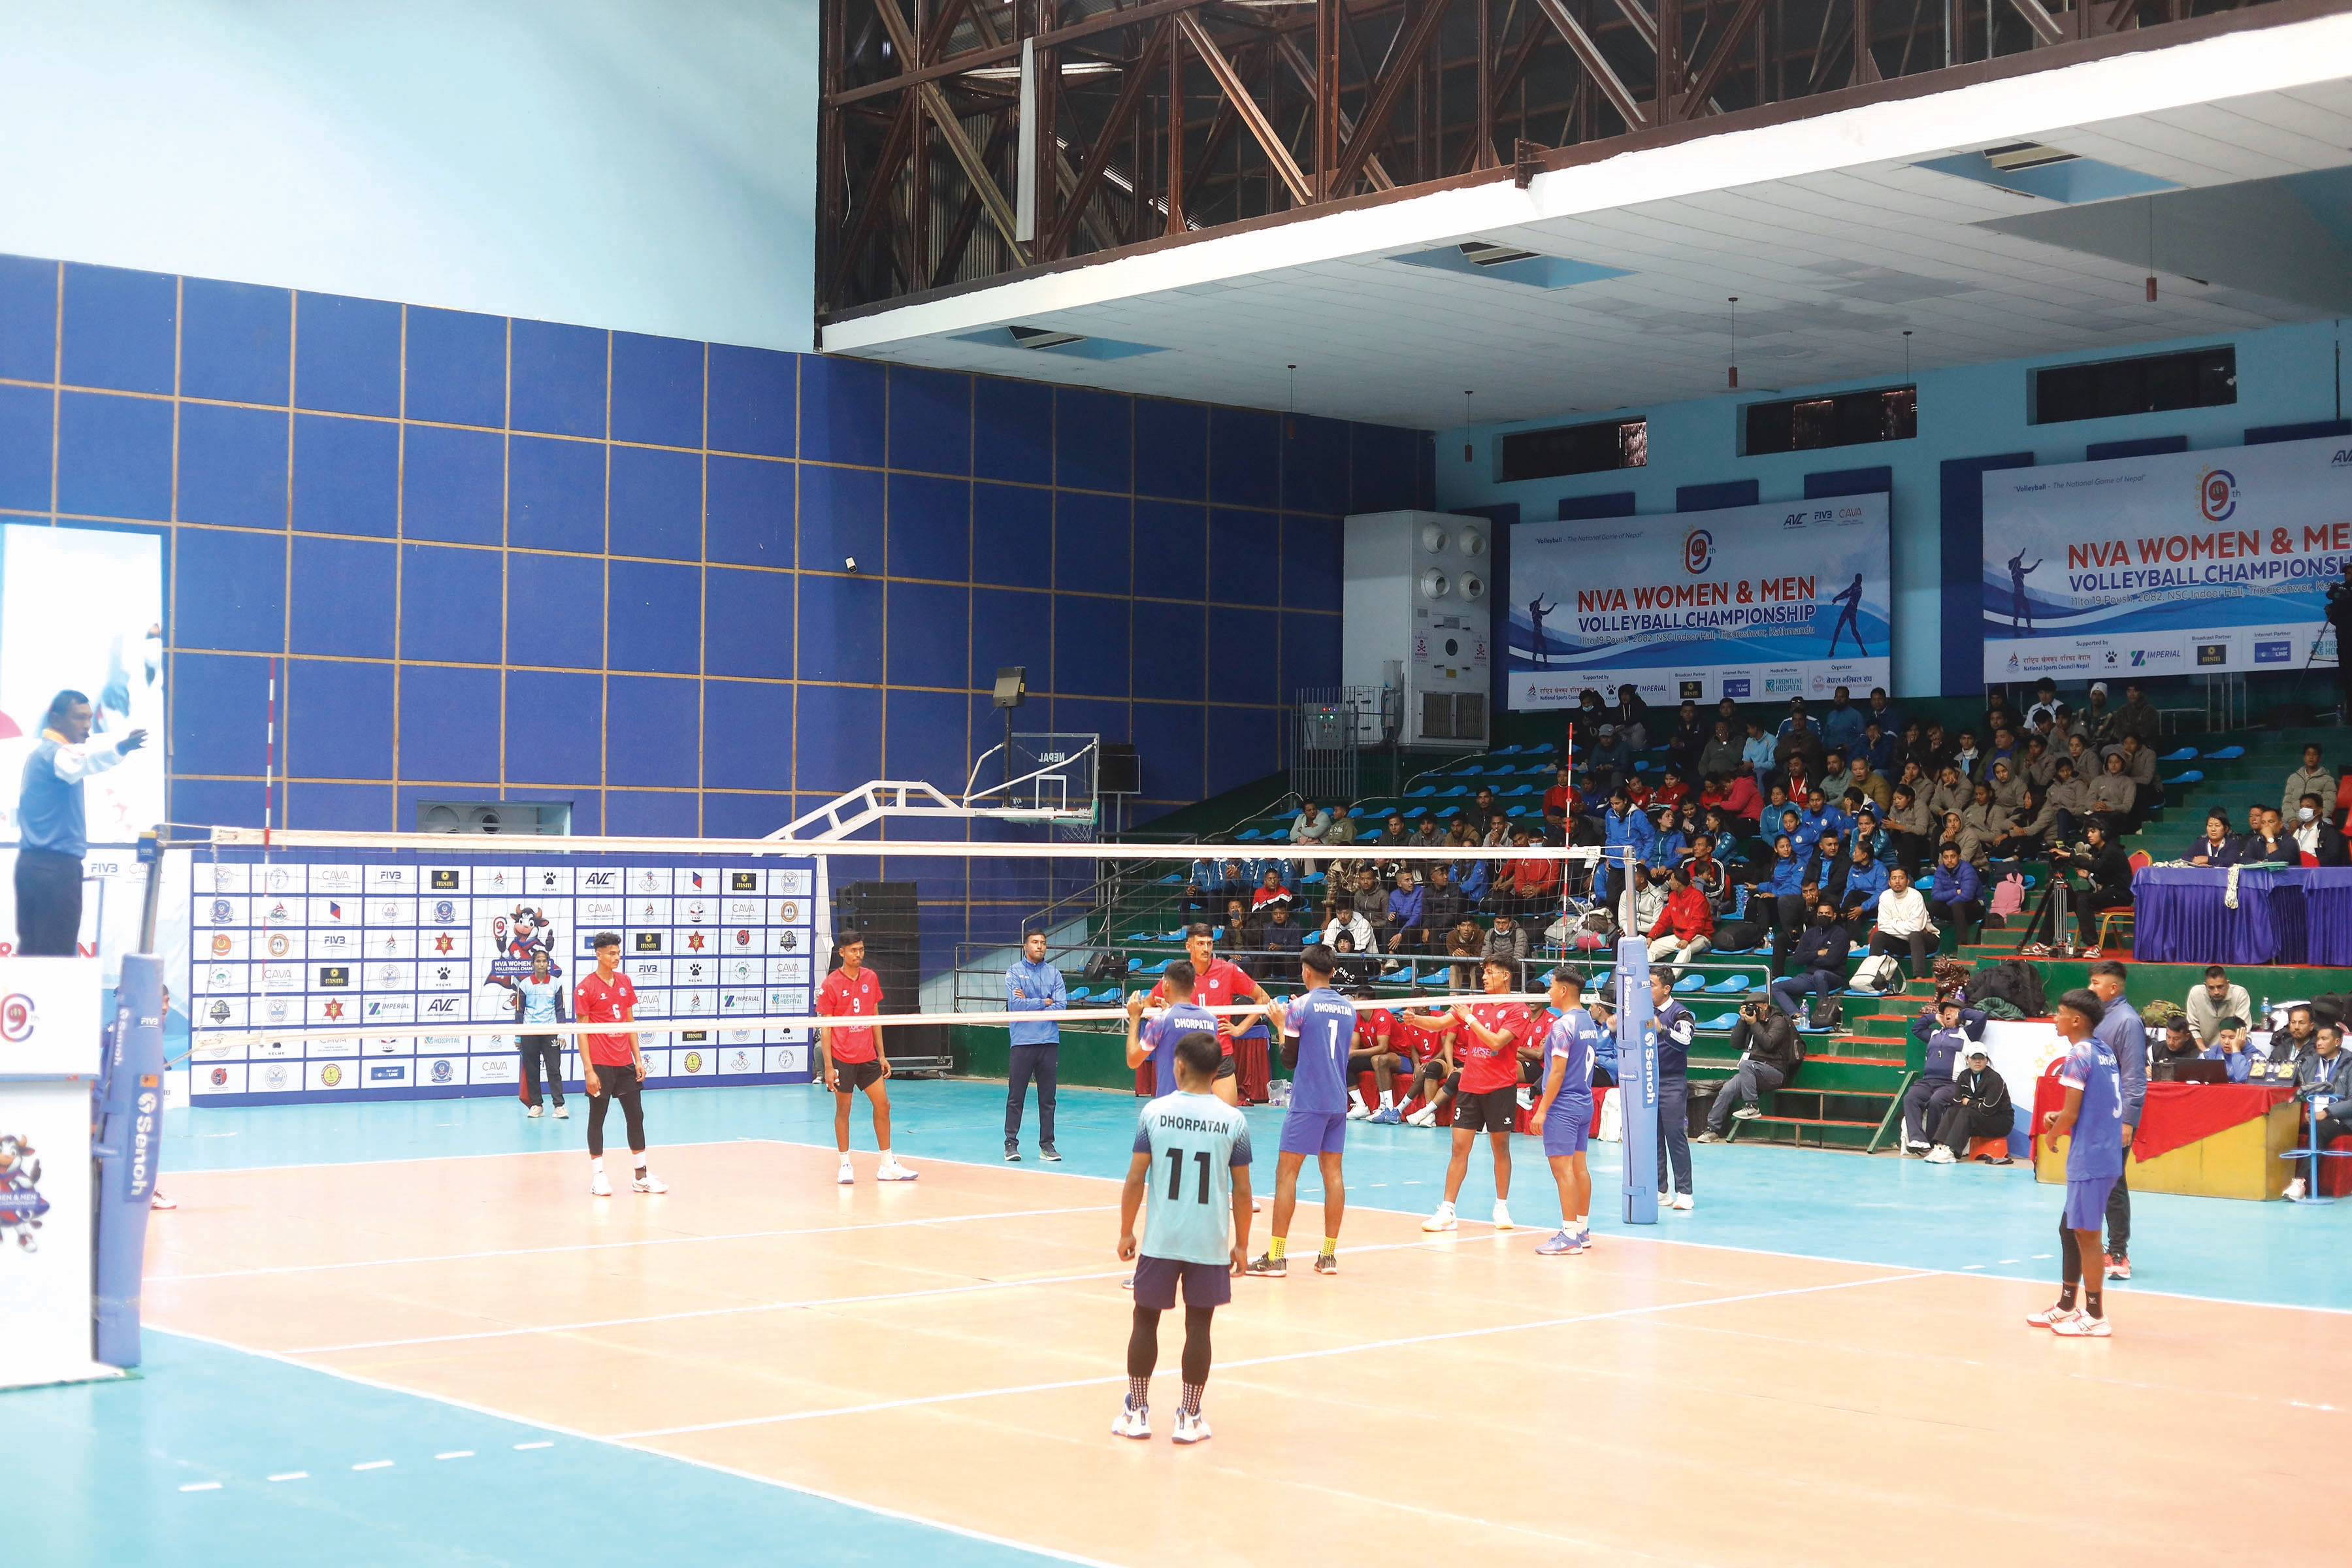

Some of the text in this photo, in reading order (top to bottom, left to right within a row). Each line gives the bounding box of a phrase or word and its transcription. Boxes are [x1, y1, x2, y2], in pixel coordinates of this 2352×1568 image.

[1783, 507, 1862, 526] AVC FIVB CAVA
[2068, 523, 2351, 569] NVA WOMEN & ME
[2069, 567, 2199, 592] VOLLEYBALL
[1578, 575, 1816, 613] NVA WOMEN & MEN
[2071, 597, 2078, 606] 11
[2092, 596, 2101, 605] 19
[2104, 594, 2135, 605] Poush,
[2168, 590, 2187, 600] NSC
[2191, 588, 2221, 598] Indoor
[2224, 588, 2246, 598] Hall,
[2248, 583, 2313, 596] Tripureshwor,
[1578, 604, 1816, 632] VOLLEYBALL CHAMPIONSHIP
[1656, 633, 1673, 642] NSC
[1674, 631, 1698, 641] Indoor
[1769, 625, 1815, 636] Kathmandu
[2147, 650, 2181, 659] IMPERIAL
[91, 863, 118, 873] FIVB
[321, 870, 350, 880] CAVA
[380, 871, 402, 879] FIVB
[585, 872, 615, 885] AVC
[587, 904, 612, 913] CAVA
[732, 904, 755, 913] CAVA
[324, 936, 346, 945] FIVB
[263, 969, 292, 979] CAVA
[638, 964, 657, 973] FIVB
[777, 963, 799, 972] CAVA
[427, 998, 459, 1012] AVC
[612, 1004, 620, 1019] 6
[853, 998, 860, 1013] 9
[1313, 1003, 1352, 1017] DHORPATAN
[1174, 1018, 1215, 1031] DHORPATAN
[1328, 1019, 1339, 1059] 1
[1424, 1039, 1430, 1051] 2
[1527, 1036, 1533, 1048] 4
[482, 1061, 508, 1071] CAVA
[1584, 1045, 1595, 1082] 9
[2249, 1062, 2266, 1076] 25
[2278, 1062, 2295, 1078] 25
[1645, 1049, 1656, 1104] Senoh
[1454, 1107, 1461, 1120] 3
[1160, 1115, 1229, 1135] DHORPATAN
[130, 1115, 154, 1196] Senoh
[1166, 1147, 1211, 1205] 11
